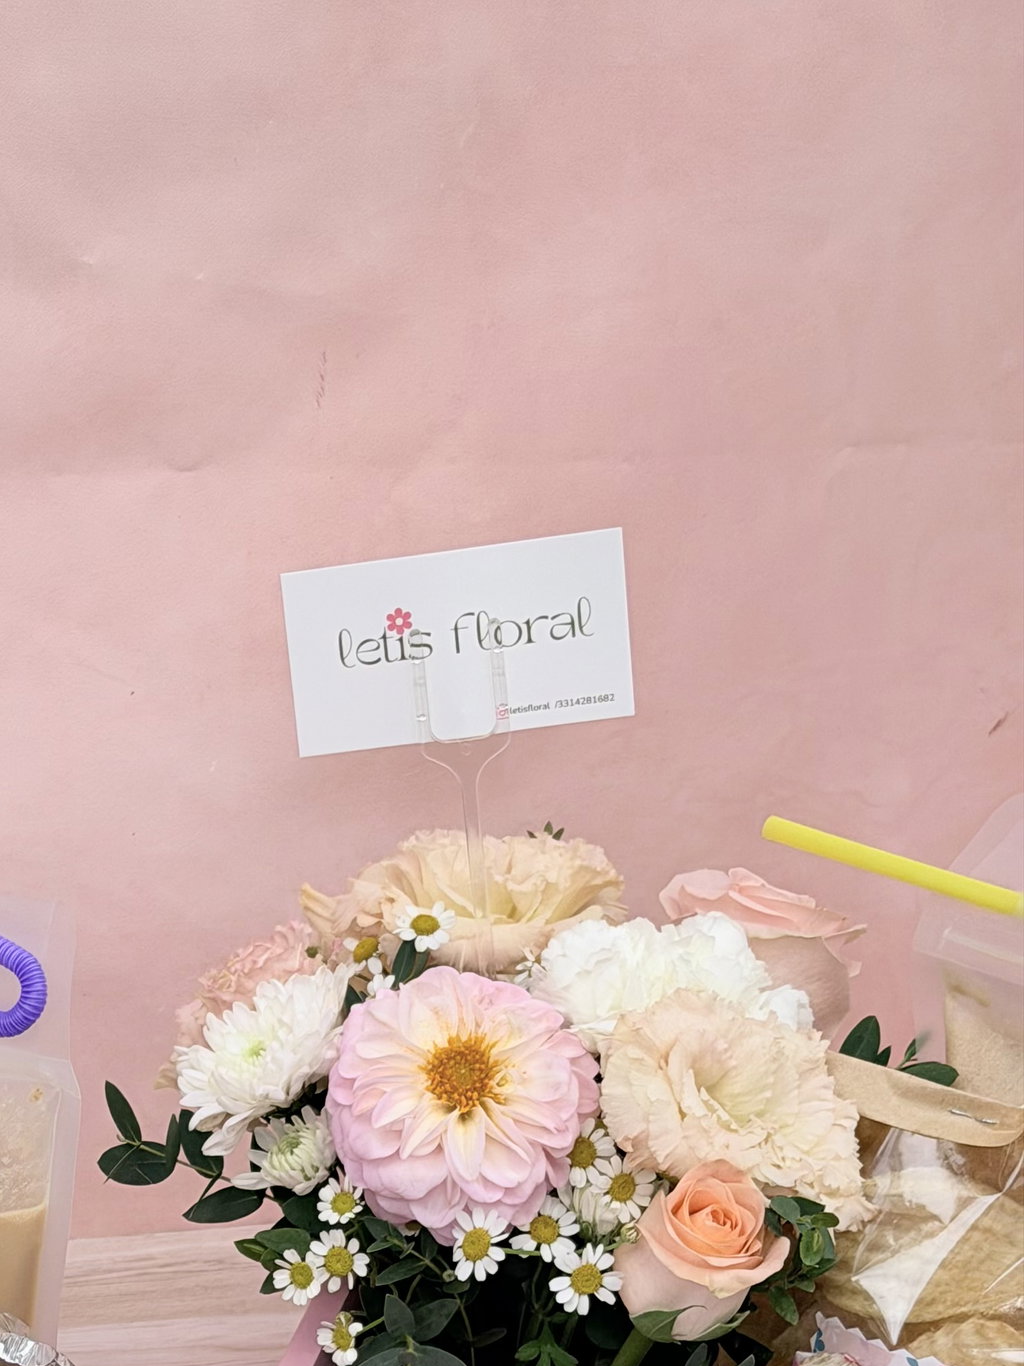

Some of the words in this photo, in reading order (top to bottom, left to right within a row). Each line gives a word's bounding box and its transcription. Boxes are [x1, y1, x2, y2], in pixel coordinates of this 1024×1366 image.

[337, 607, 434, 669] letis
[449, 595, 595, 655] floral
[509, 702, 551, 715] letisfloral
[554, 693, 616, 710] /3314281682
